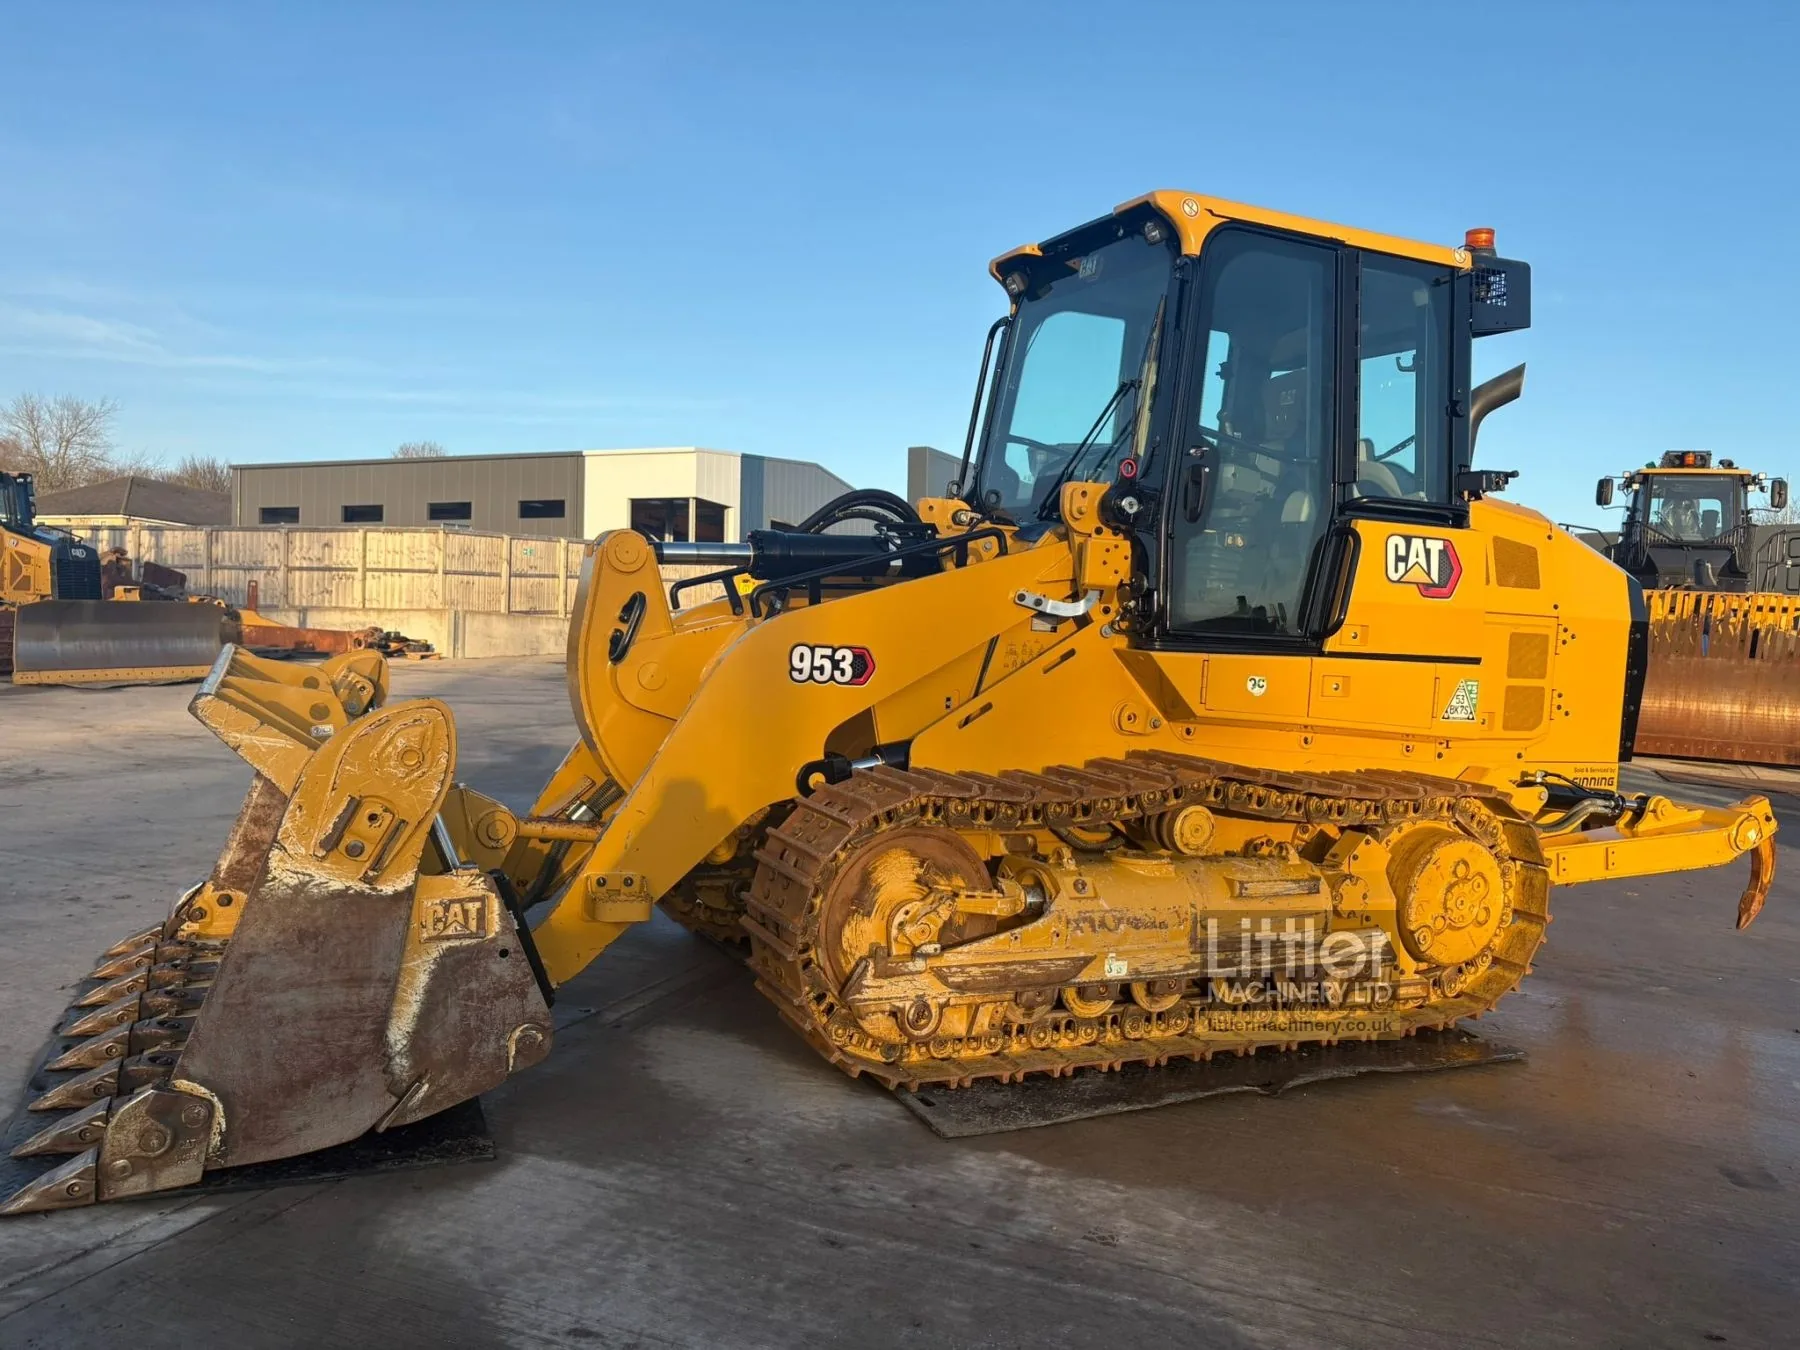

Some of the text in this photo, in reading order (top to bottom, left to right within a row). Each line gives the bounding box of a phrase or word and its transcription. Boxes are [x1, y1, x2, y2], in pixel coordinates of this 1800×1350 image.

[1386, 534, 1444, 585] CAT
[790, 644, 854, 683] 953
[1455, 694, 1465, 704] 53
[426, 902, 481, 937] CAT
